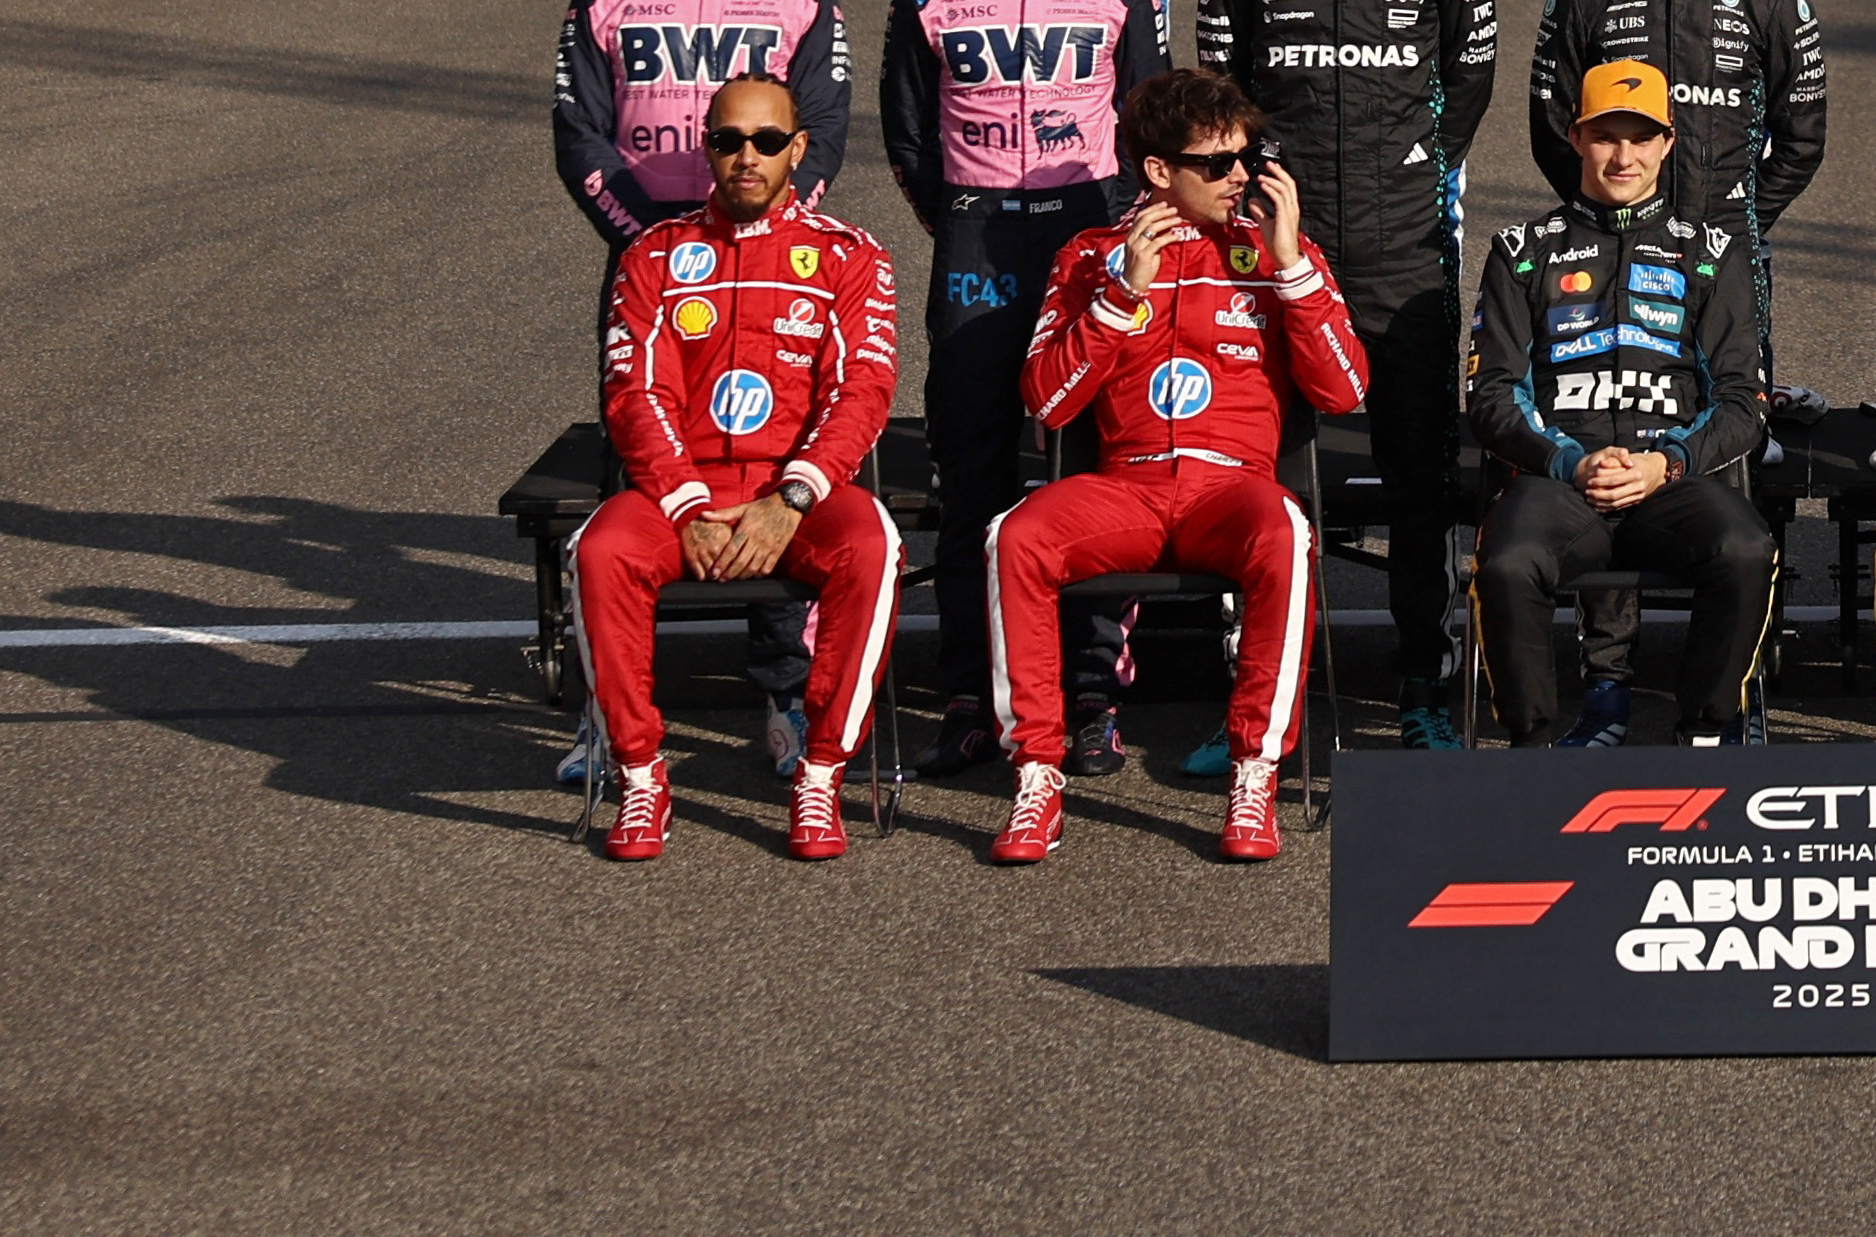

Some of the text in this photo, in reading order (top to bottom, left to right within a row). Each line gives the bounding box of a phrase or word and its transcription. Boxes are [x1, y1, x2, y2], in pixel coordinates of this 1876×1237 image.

[638, 3, 676, 16] MSC
[961, 5, 998, 19] MSC
[1273, 11, 1315, 21] Snapdragon
[1473, 1, 1493, 23] IWC
[1713, 5, 1744, 17] PETRONAS
[1619, 16, 1645, 29] UBS
[1603, 36, 1649, 48] CROWDSTRIKE
[619, 22, 782, 86] BWT
[938, 22, 1109, 87] BWT
[1267, 44, 1419, 68] PETRONAS
[1803, 46, 1823, 66] IWC
[631, 114, 698, 154] eni
[961, 112, 1020, 150] eni
[595, 189, 643, 237] BWT
[1029, 198, 1063, 215] FRANCO
[733, 218, 773, 240] IBM
[1549, 244, 1599, 264] Android
[673, 249, 709, 282] hp
[947, 272, 1019, 308] FC43
[1642, 281, 1671, 291] CISCO
[1214, 310, 1267, 329] UniCredit
[1557, 316, 1599, 331] DP WORLD
[1633, 303, 1679, 326] allwyn
[774, 318, 824, 338] UniCredit
[776, 350, 814, 365] CEVA
[1216, 343, 1259, 357] CEVA
[1555, 337, 1597, 357] DELL
[1320, 322, 1365, 402] RICHARD MILLE
[1064, 360, 1092, 392] MILLE
[1157, 362, 1206, 419] hp
[1553, 370, 1678, 415] OKX
[717, 376, 768, 434] hp
[1560, 787, 1727, 833] F1
[1627, 845, 1753, 865] FORMULA
[1760, 846, 1776, 863] 1
[1640, 878, 1785, 923] ABU
[1614, 926, 1857, 973] GRAND
[1772, 983, 1872, 1008] 2025
